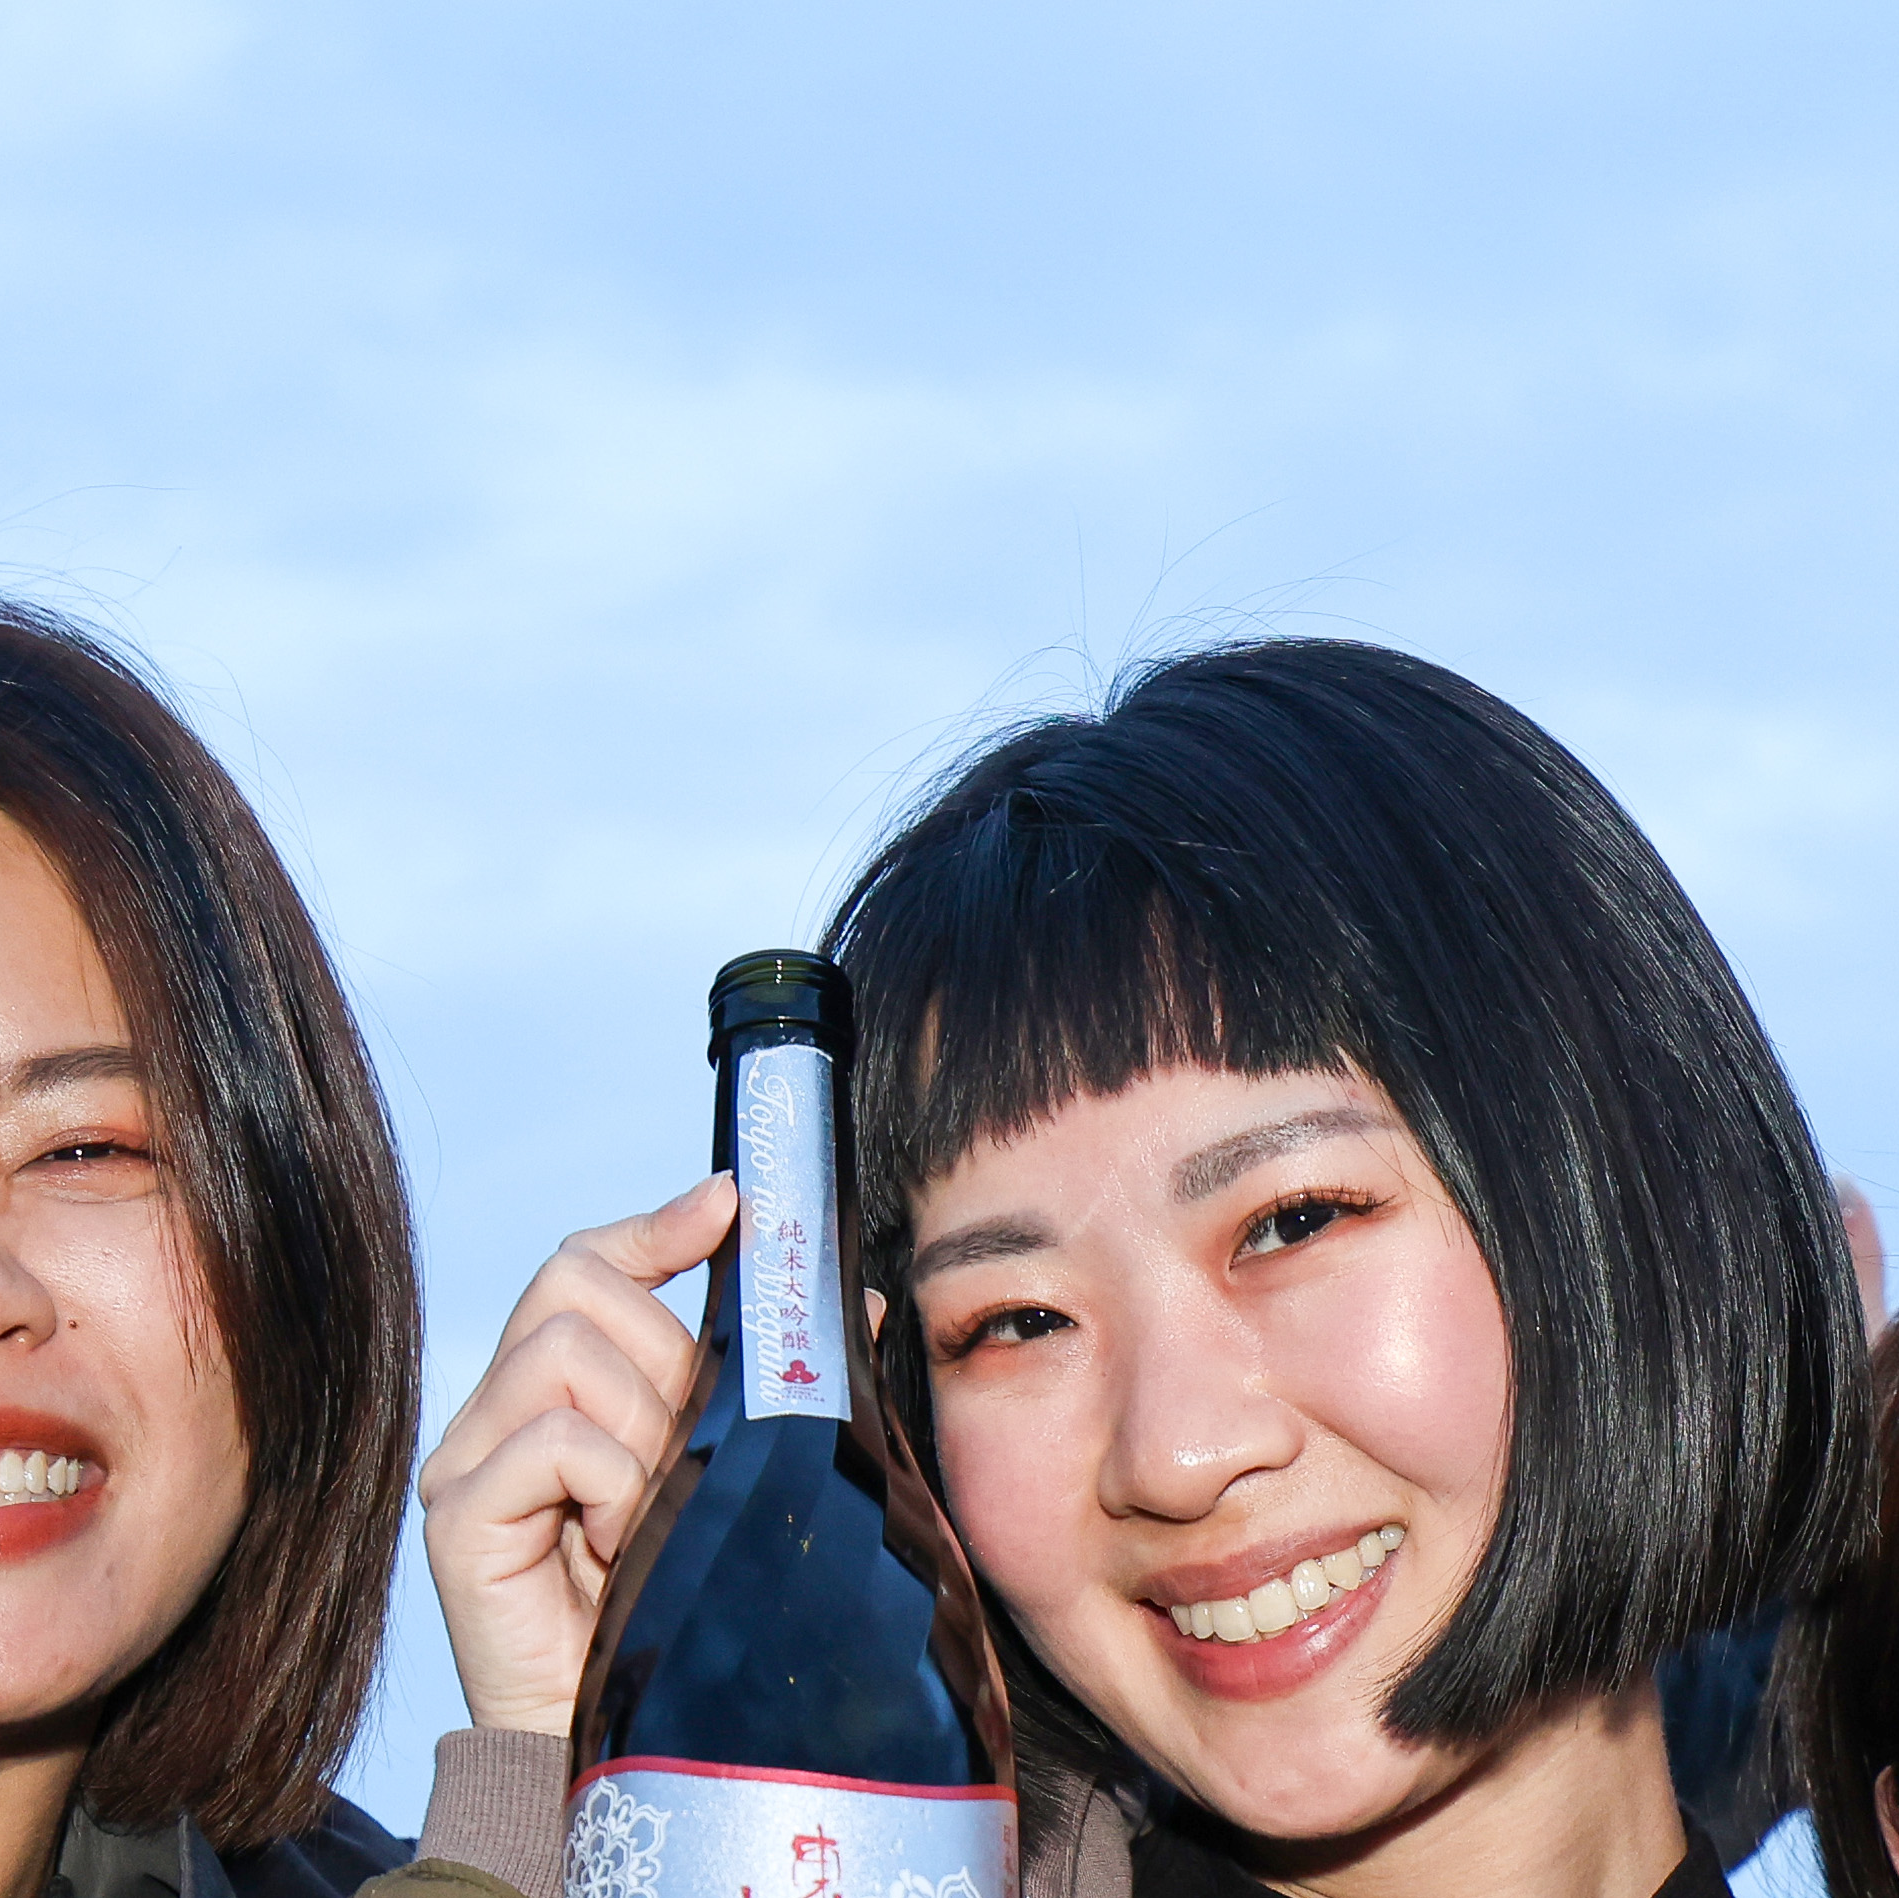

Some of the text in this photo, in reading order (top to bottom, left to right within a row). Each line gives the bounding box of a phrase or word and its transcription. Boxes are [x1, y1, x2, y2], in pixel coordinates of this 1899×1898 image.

[739, 1058, 794, 1180] Toyo
[751, 1185, 783, 1241] no
[741, 1250, 804, 1407] Megami
[777, 1219, 812, 1350] 純米大吟醸
